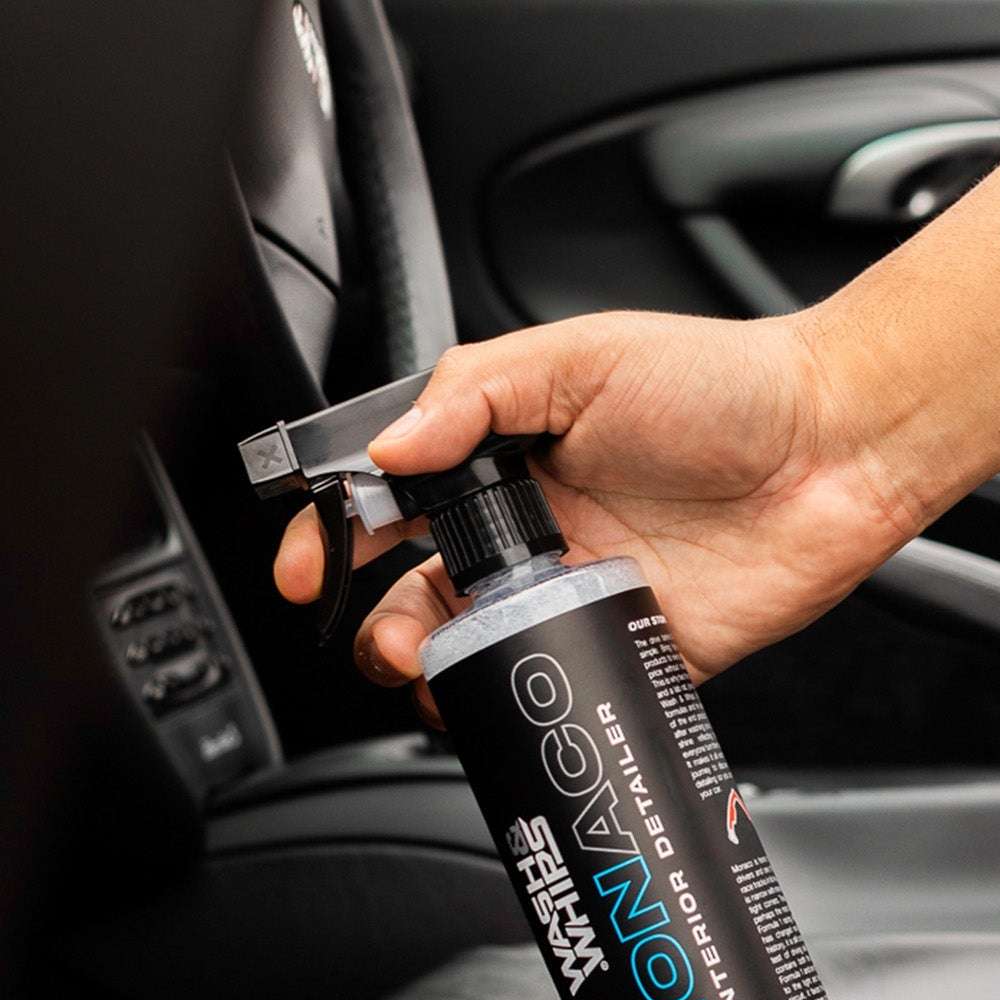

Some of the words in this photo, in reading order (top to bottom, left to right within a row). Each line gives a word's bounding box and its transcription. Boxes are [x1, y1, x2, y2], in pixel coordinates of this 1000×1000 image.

[627, 618, 651, 631] OUR
[596, 700, 675, 859] DETAILER
[517, 815, 605, 979] WHIPS
